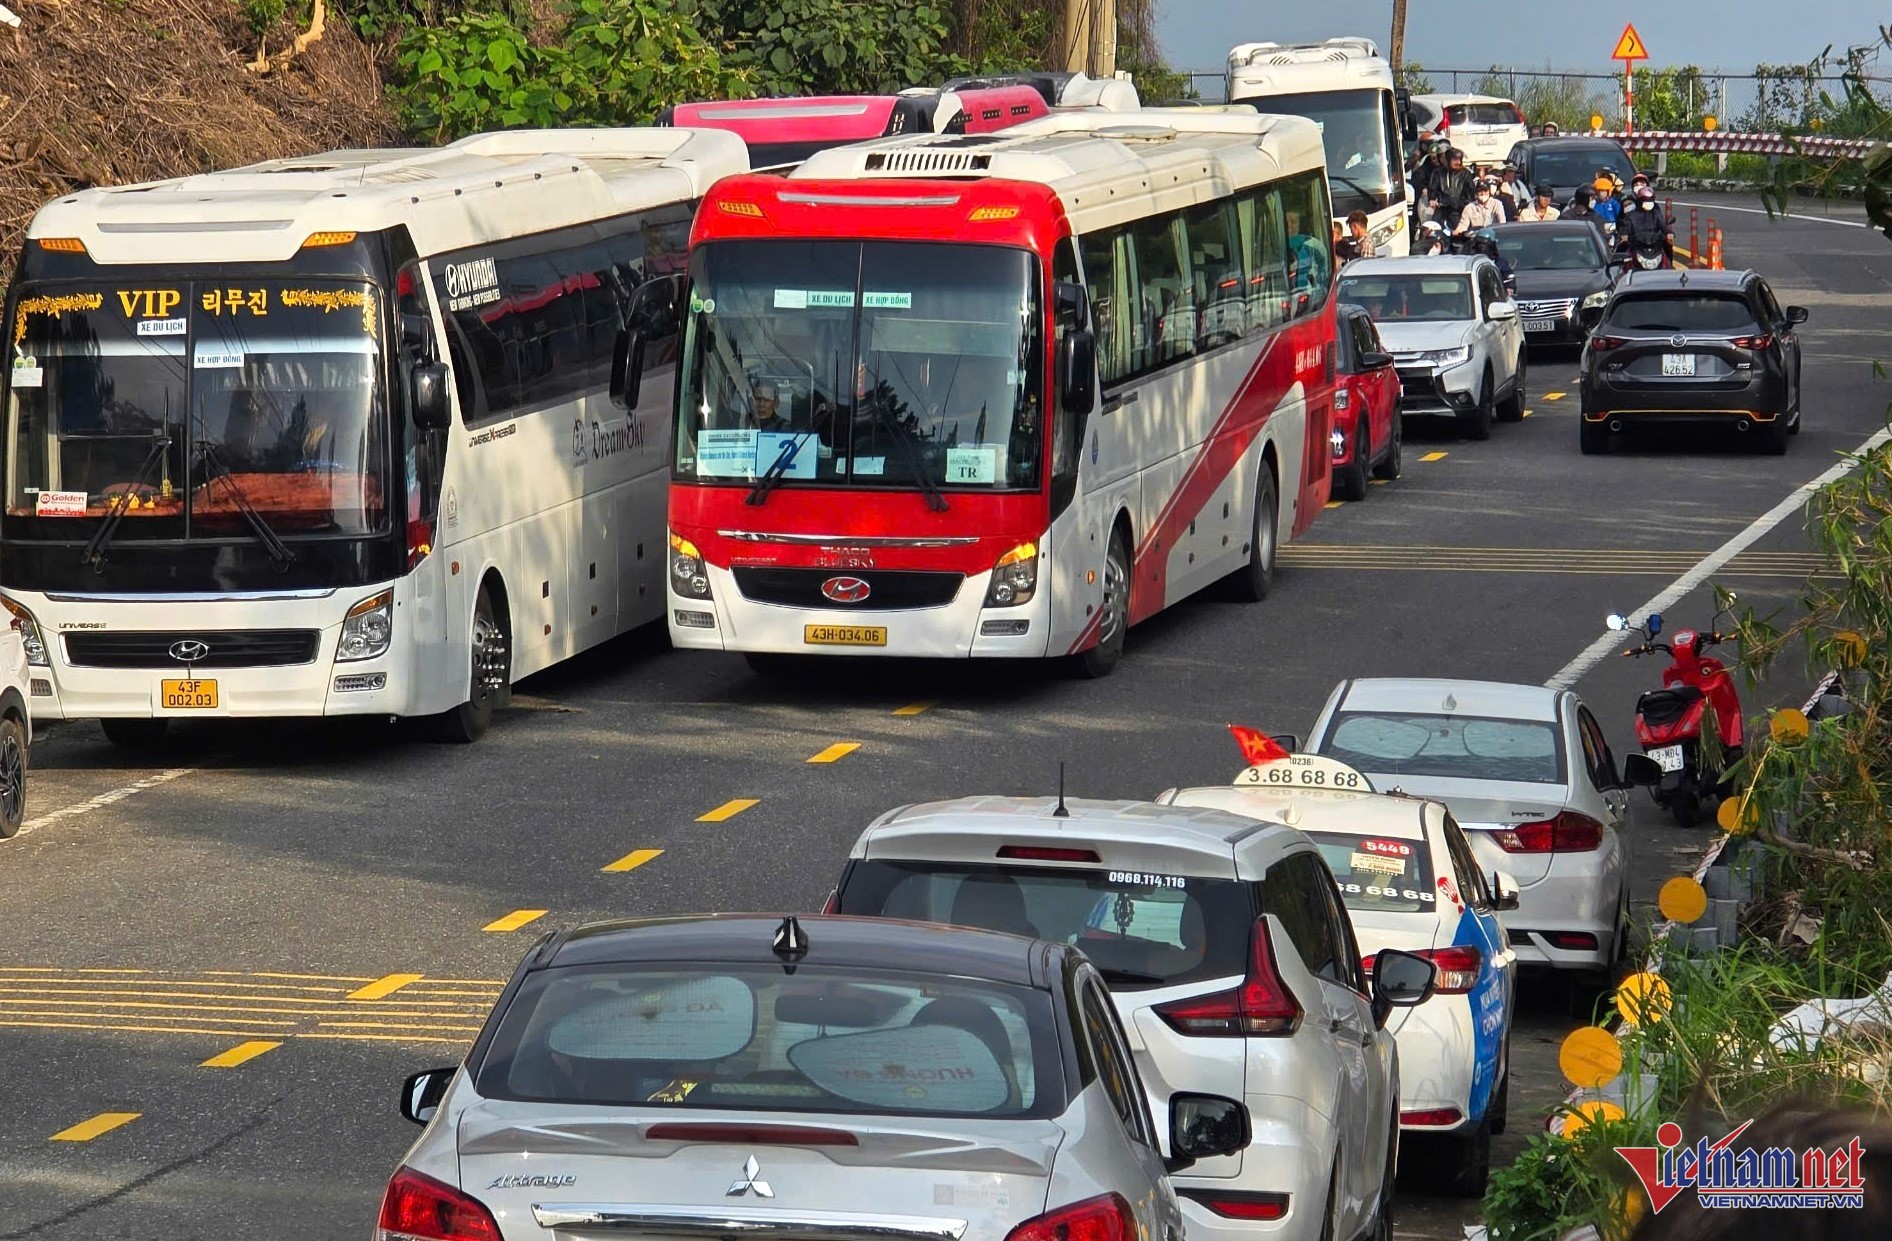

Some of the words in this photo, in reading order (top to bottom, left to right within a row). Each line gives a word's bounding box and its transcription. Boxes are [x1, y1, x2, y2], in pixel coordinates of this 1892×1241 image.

[457, 257, 498, 293] HYUNDAI
[117, 290, 181, 317] VIP
[202, 289, 267, 316] 리무진
[812, 294, 820, 303] XE
[823, 294, 833, 303] DU
[866, 296, 873, 304] XE
[141, 322, 151, 332] XE
[153, 322, 164, 331] DU
[166, 321, 183, 333] LỊCH
[197, 356, 206, 364] XE
[1670, 354, 1687, 364] 43A
[1664, 365, 1693, 375] 426.52
[778, 439, 798, 470] 2
[958, 466, 977, 478] TR
[51, 494, 84, 502] Golden
[812, 628, 879, 642] 43H-034.06
[178, 681, 201, 693] 43F
[169, 694, 212, 706] 002.03
[1248, 768, 1293, 784] 3.68
[1301, 769, 1325, 784] 68
[1334, 771, 1358, 787] 68
[1366, 841, 1410, 855] 5449
[1108, 871, 1186, 889] 0968.114.116
[1366, 886, 1398, 898] 68
[1403, 889, 1435, 902] 68
[485, 1173, 577, 1190] Attrage
